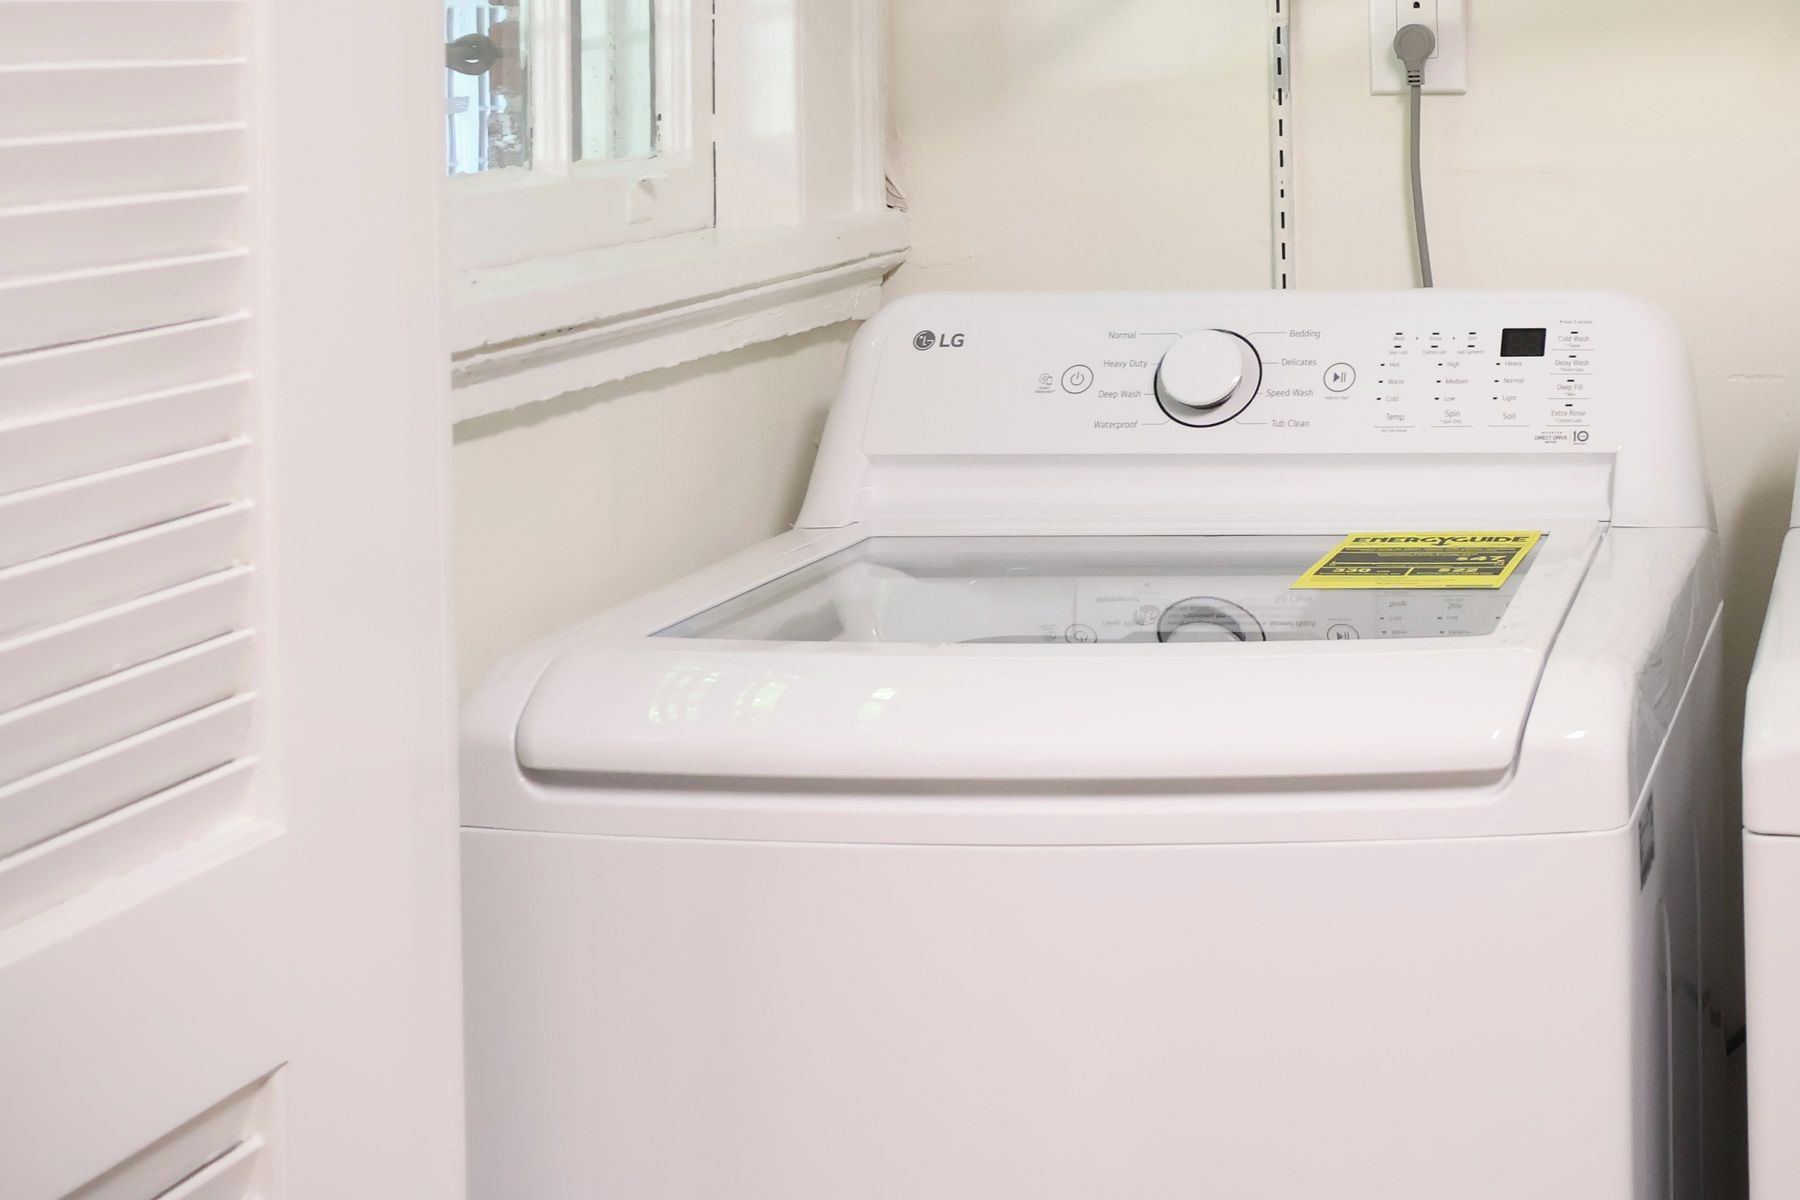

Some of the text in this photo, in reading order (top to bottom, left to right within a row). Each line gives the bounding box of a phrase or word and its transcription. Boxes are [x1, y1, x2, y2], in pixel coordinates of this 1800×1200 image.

[1107, 331, 1137, 340] Normal
[1289, 329, 1321, 339] Bedding
[939, 333, 965, 347] LG
[1103, 359, 1148, 369] Heavy Duty
[1281, 358, 1317, 366] Delicates
[1098, 390, 1142, 399] Deep Wash
[1266, 389, 1314, 398] Speed Wash
[1386, 412, 1405, 422] Temp
[1444, 409, 1461, 419] Spin
[1502, 412, 1517, 420] Soil
[1094, 420, 1139, 430] Waterproof
[1272, 419, 1310, 427] Tub Clean
[1352, 536, 1530, 546] ENERGYGUIDE
